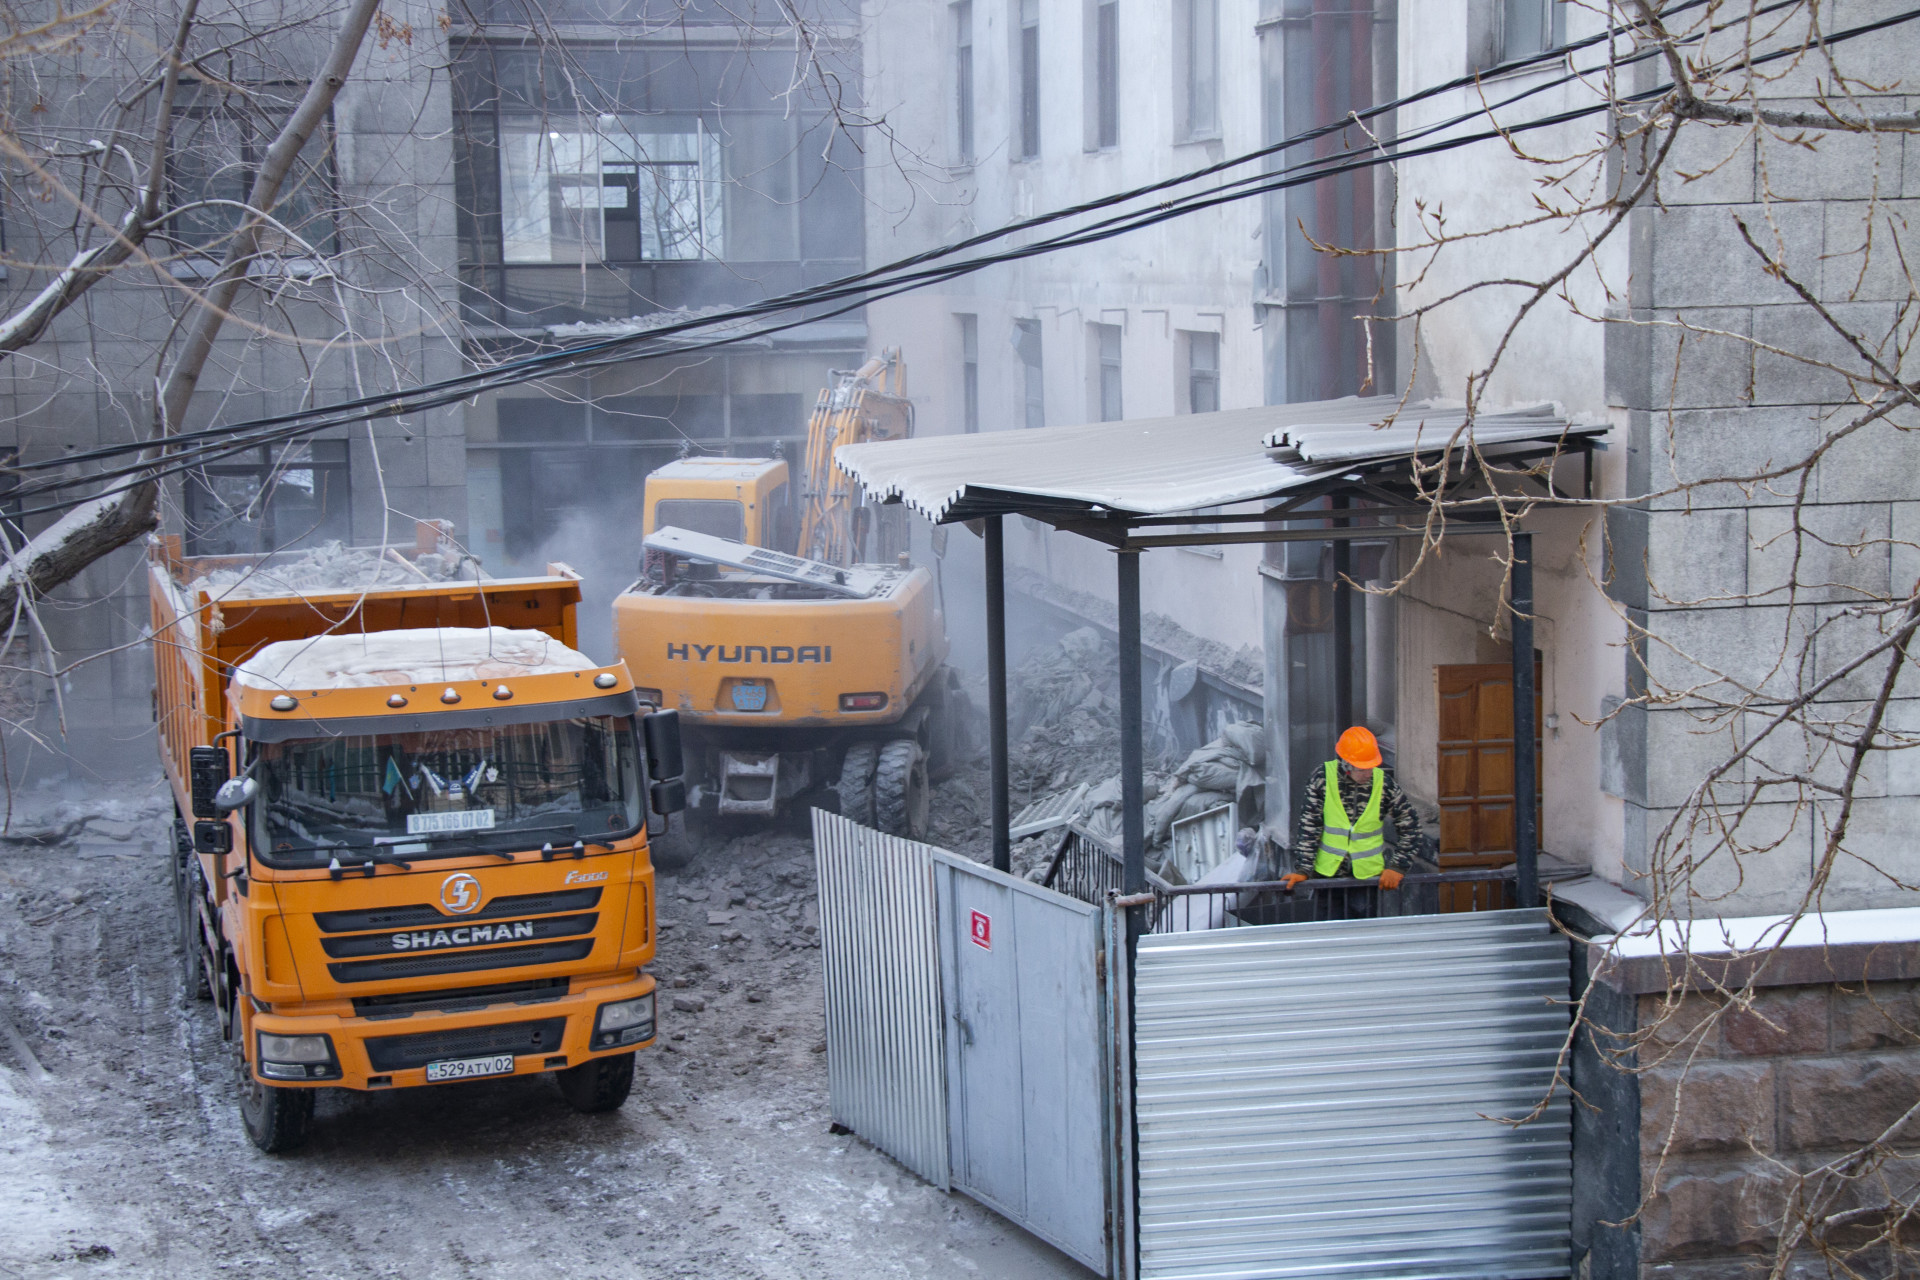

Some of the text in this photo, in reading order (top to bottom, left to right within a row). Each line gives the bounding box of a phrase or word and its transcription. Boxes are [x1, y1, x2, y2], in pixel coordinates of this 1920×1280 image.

[667, 642, 832, 664] HYUNDAI
[412, 816, 420, 831] 8
[421, 815, 439, 830] 775
[440, 813, 460, 829] 166
[476, 811, 489, 826] 02
[564, 870, 609, 885] F3000
[391, 921, 534, 949] SHACMAN
[495, 1057, 512, 1071] 02
